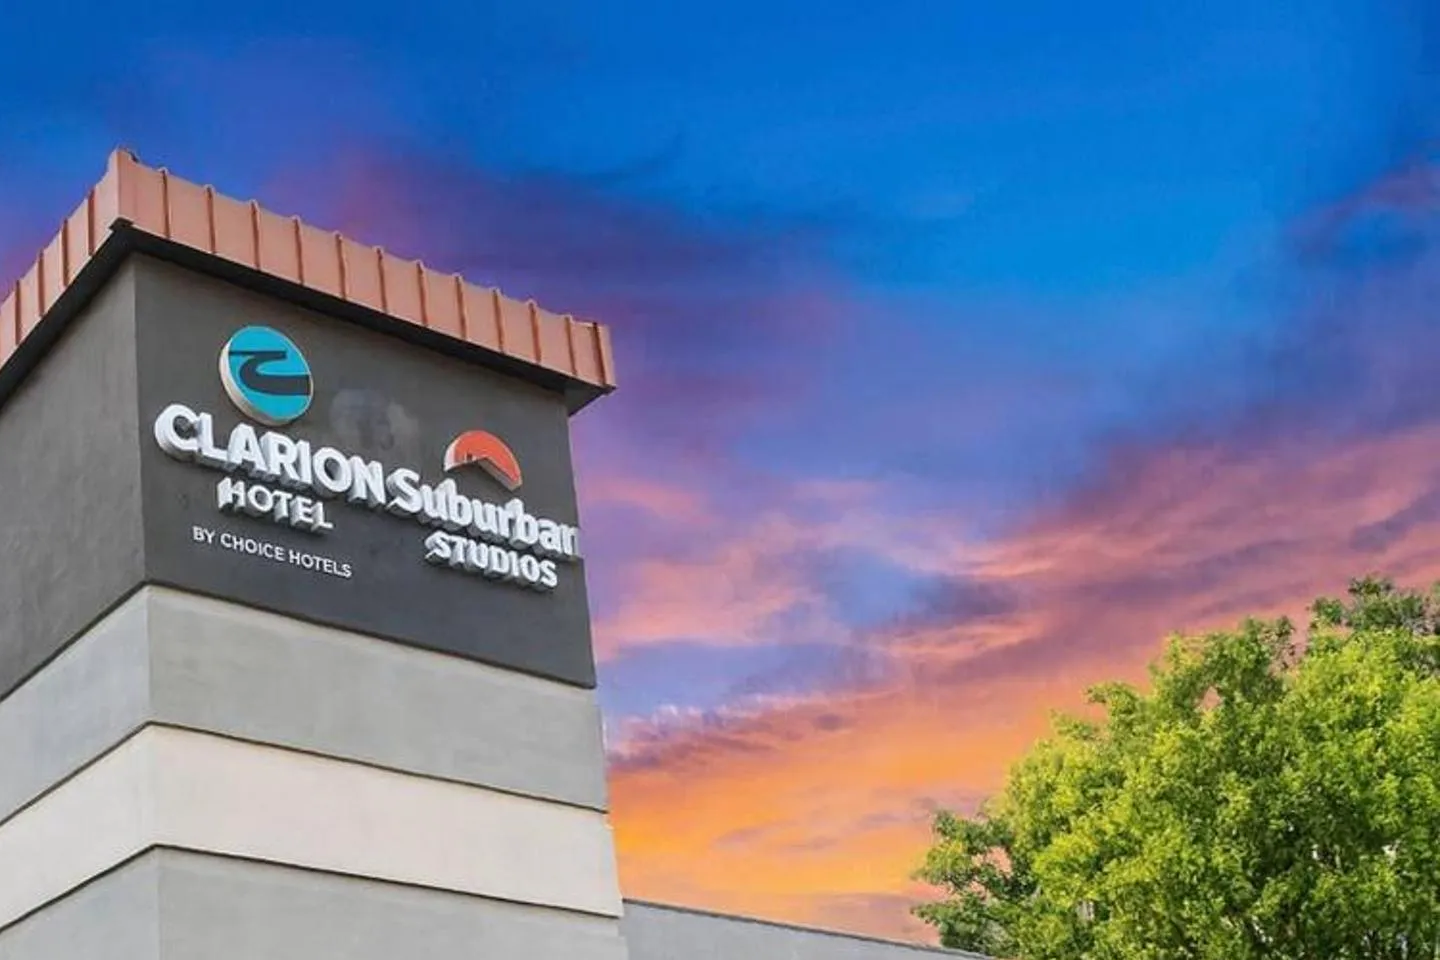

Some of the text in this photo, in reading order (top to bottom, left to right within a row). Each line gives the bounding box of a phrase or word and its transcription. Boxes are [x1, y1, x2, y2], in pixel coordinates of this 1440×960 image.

[154, 403, 387, 505] CLARION
[217, 476, 334, 534] HOTEL
[386, 468, 580, 560] Suburban
[193, 526, 352, 578] BY CHOICE HOTELS
[424, 530, 559, 590] STUDIOS
